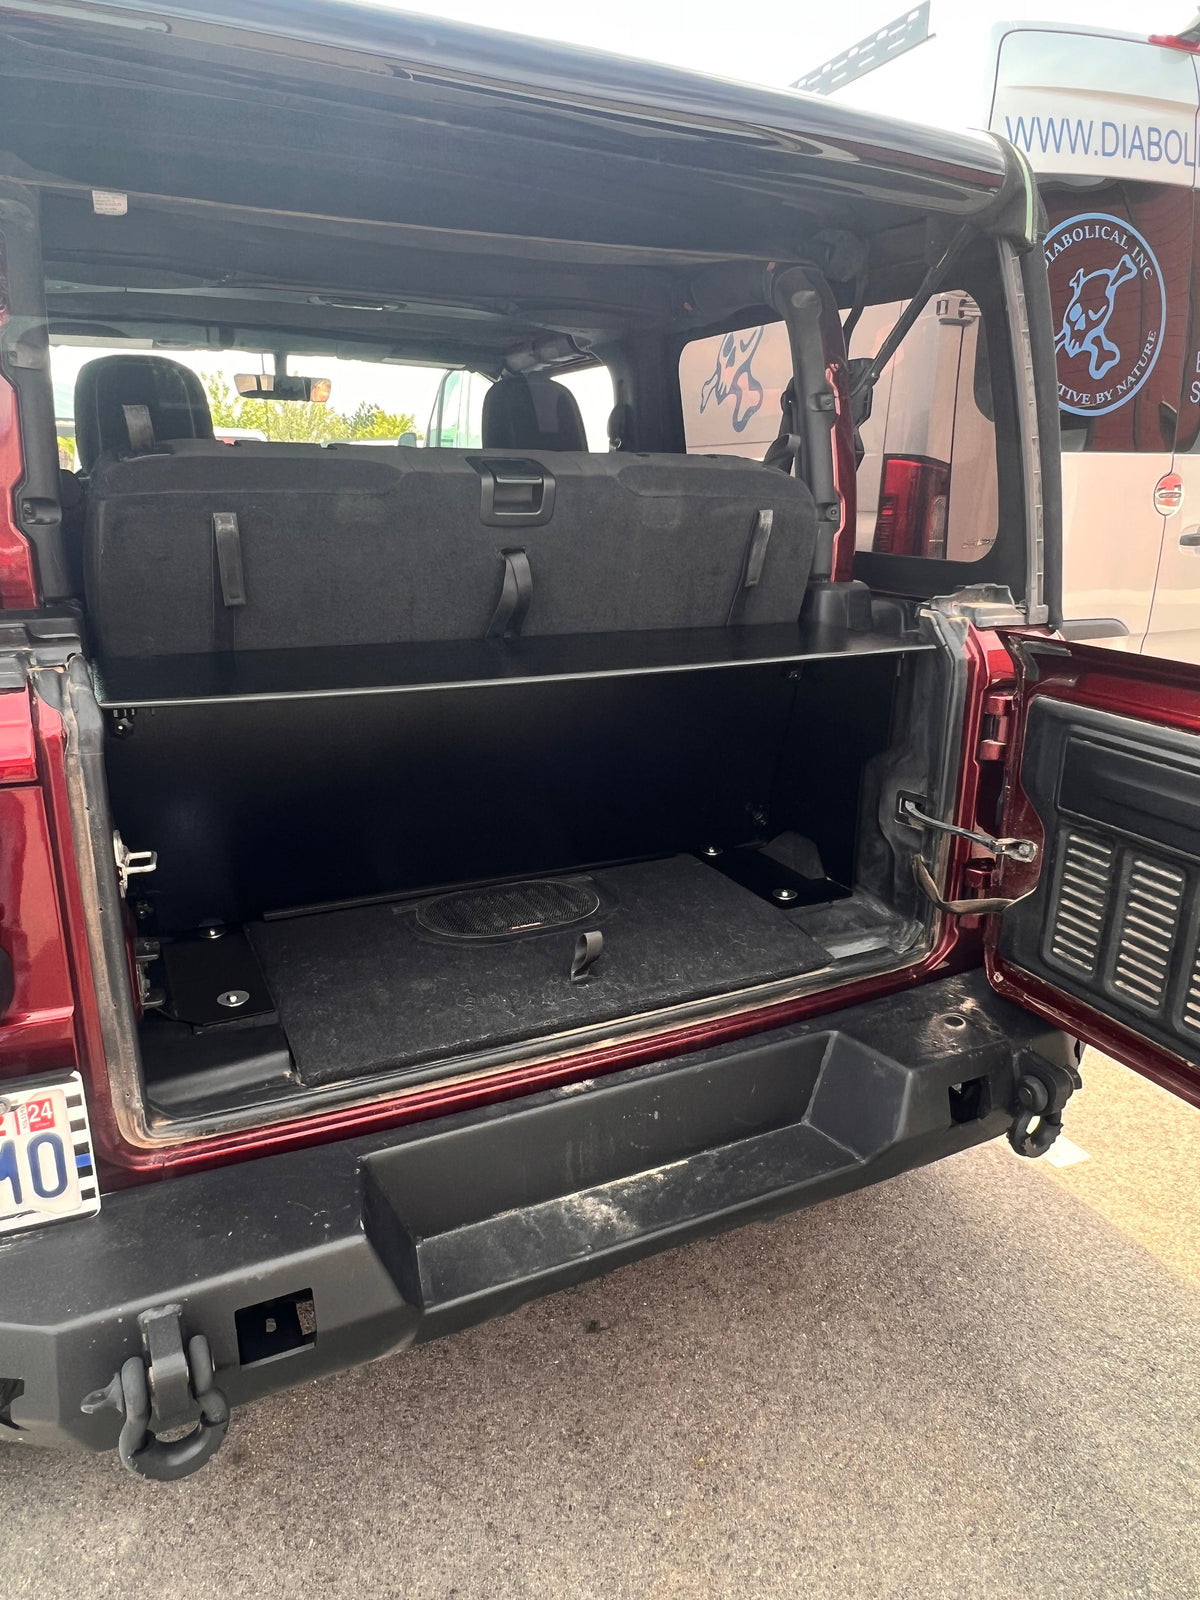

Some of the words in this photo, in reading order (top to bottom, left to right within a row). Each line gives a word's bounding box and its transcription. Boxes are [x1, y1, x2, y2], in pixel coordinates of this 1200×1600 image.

[1005, 115, 1200, 169] WWW.DIABOL
[1045, 224, 1129, 269] IABOLICAL
[1131, 246, 1153, 280] INC
[1057, 381, 1091, 405] TIVE
[1095, 387, 1113, 405] BY
[1116, 330, 1157, 395] NATURE
[27, 1101, 53, 1123] 24
